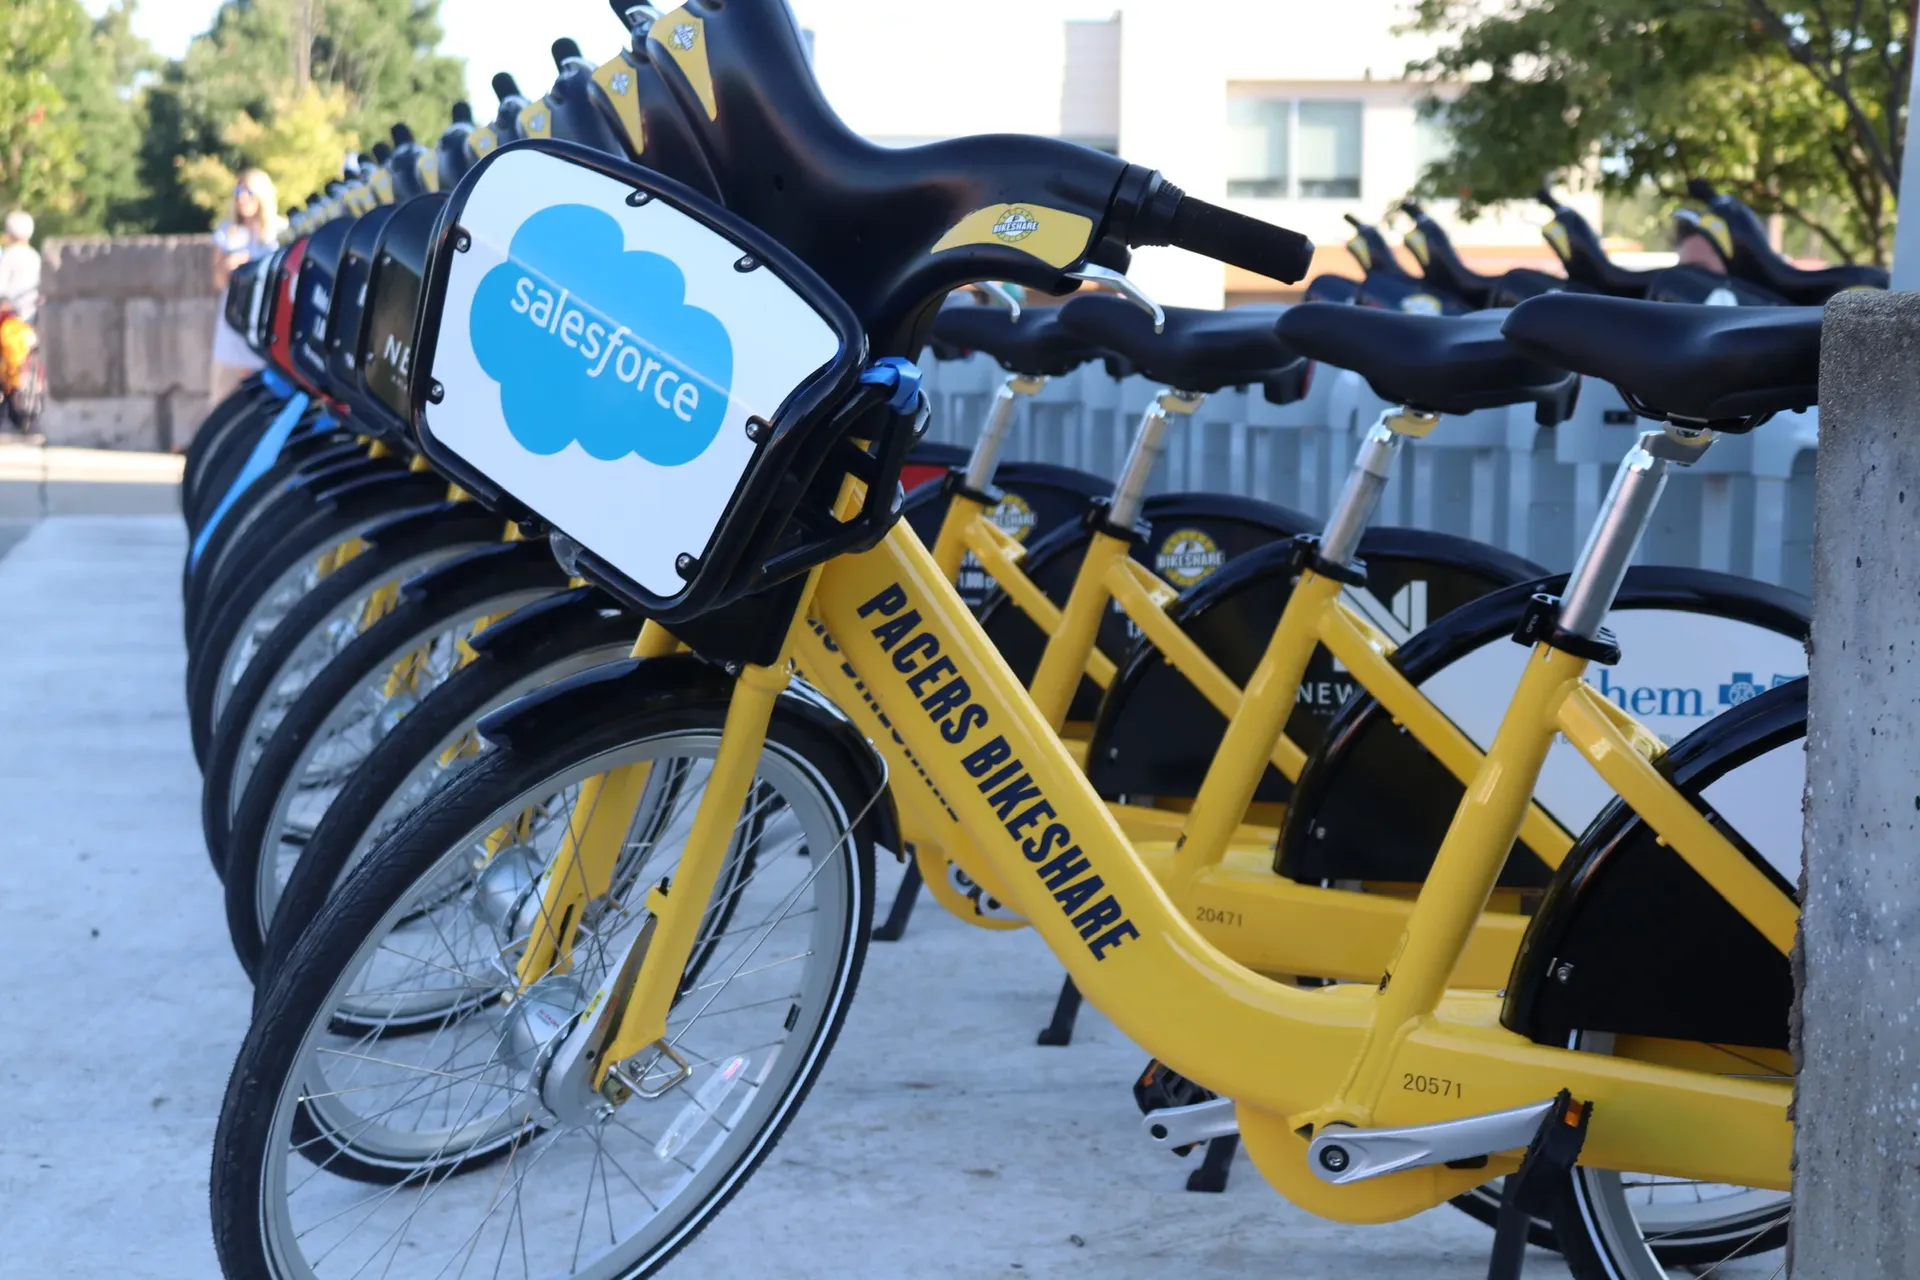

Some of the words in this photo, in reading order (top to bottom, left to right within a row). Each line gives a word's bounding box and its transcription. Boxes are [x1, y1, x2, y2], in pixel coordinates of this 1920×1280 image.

[992, 220, 1039, 234] BIKESHARE
[510, 276, 700, 423] salesforce
[1156, 549, 1225, 570] BIKESHARE
[856, 582, 989, 745] PACERS
[960, 735, 1141, 962] BIKESHARE
[1195, 905, 1243, 928] 20471
[1403, 1073, 1462, 1099] 20571
